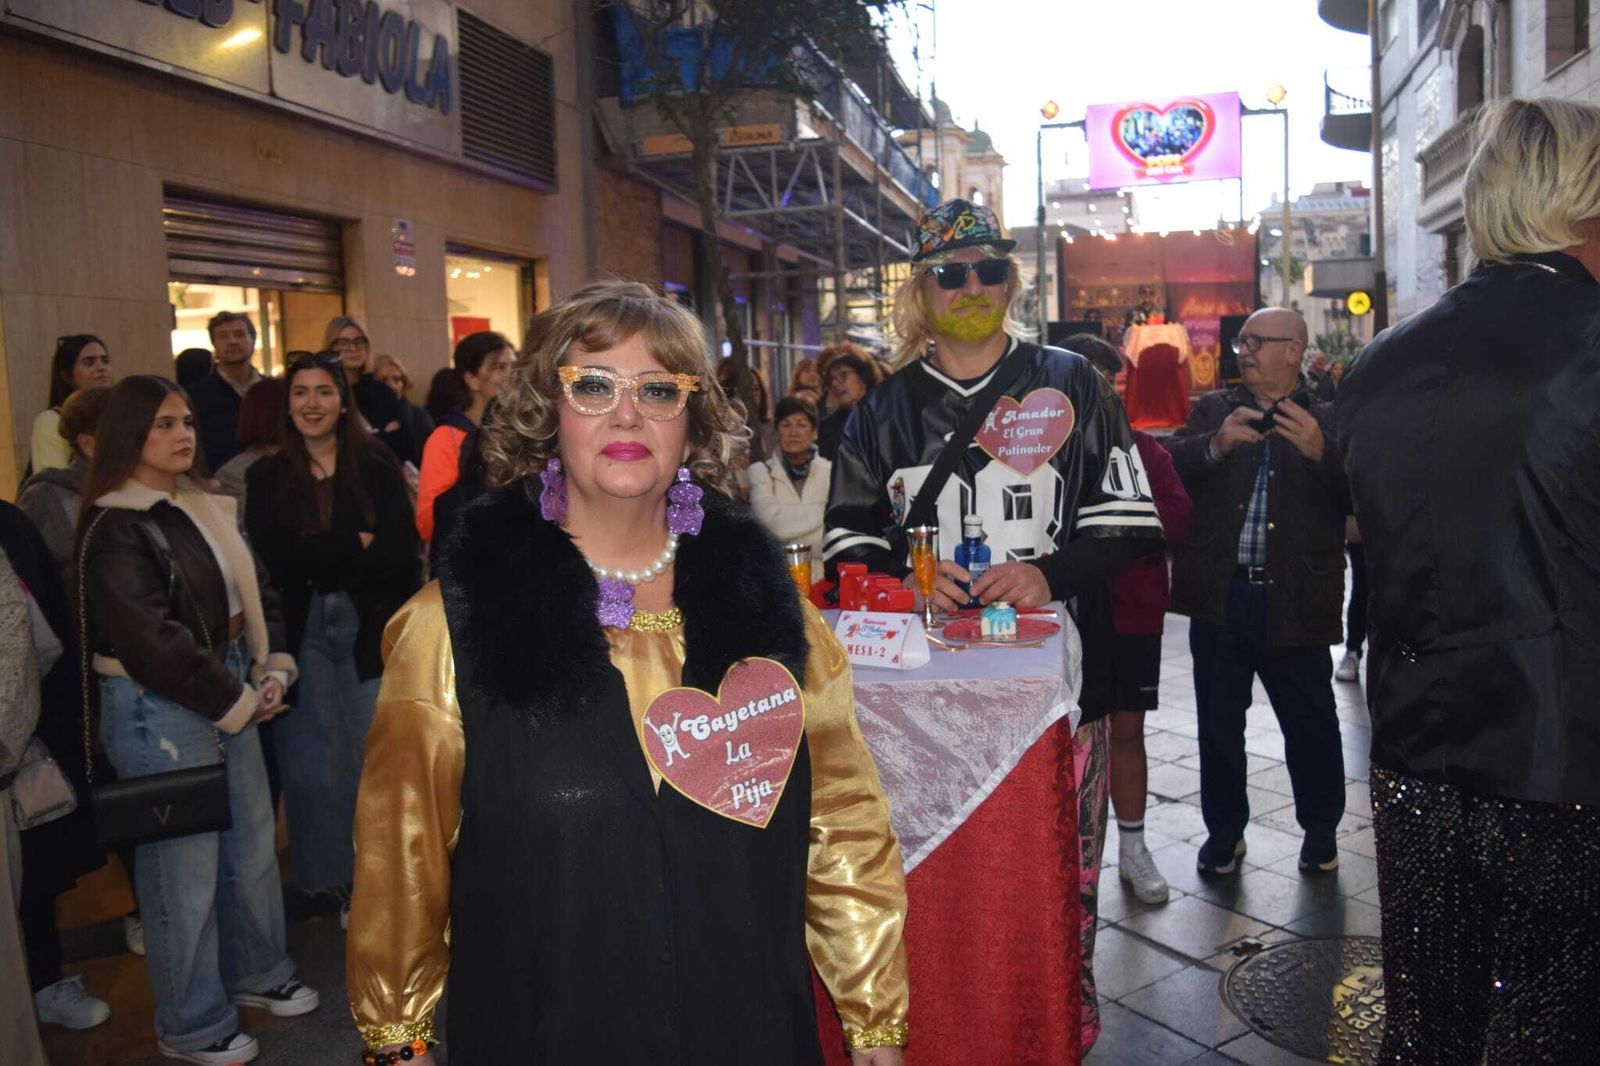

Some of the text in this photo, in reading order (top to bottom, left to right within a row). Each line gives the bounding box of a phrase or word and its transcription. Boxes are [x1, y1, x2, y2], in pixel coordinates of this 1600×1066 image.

[272, 0, 450, 115] FABIOLA
[1001, 407, 1065, 425] Amador
[1003, 426, 1044, 440] El Gran
[997, 442, 1054, 457] Patinador
[680, 687, 798, 741] Cayetana
[725, 740, 753, 766] La
[730, 777, 773, 810] Pija
